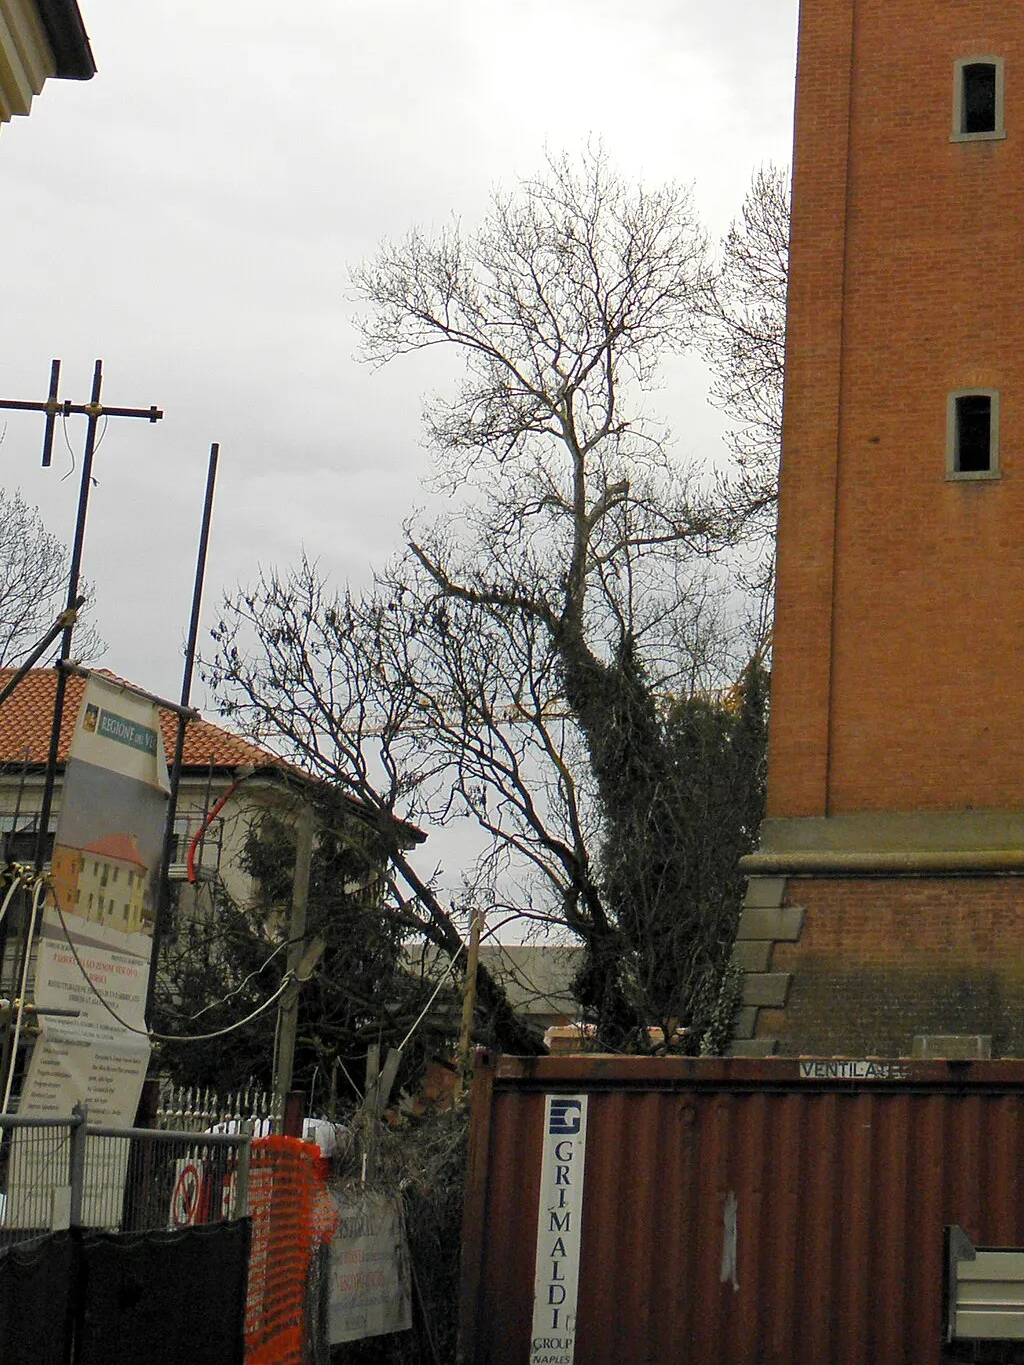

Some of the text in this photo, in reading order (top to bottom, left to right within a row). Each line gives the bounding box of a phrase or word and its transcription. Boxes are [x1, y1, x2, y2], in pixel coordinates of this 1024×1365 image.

[102, 717, 135, 740] REGIONE
[799, 1061, 912, 1078] VENTILA
[548, 1140, 574, 1329] GRIMALDI
[533, 1337, 572, 1350] GROUP
[533, 1355, 570, 1365] NAPLES
